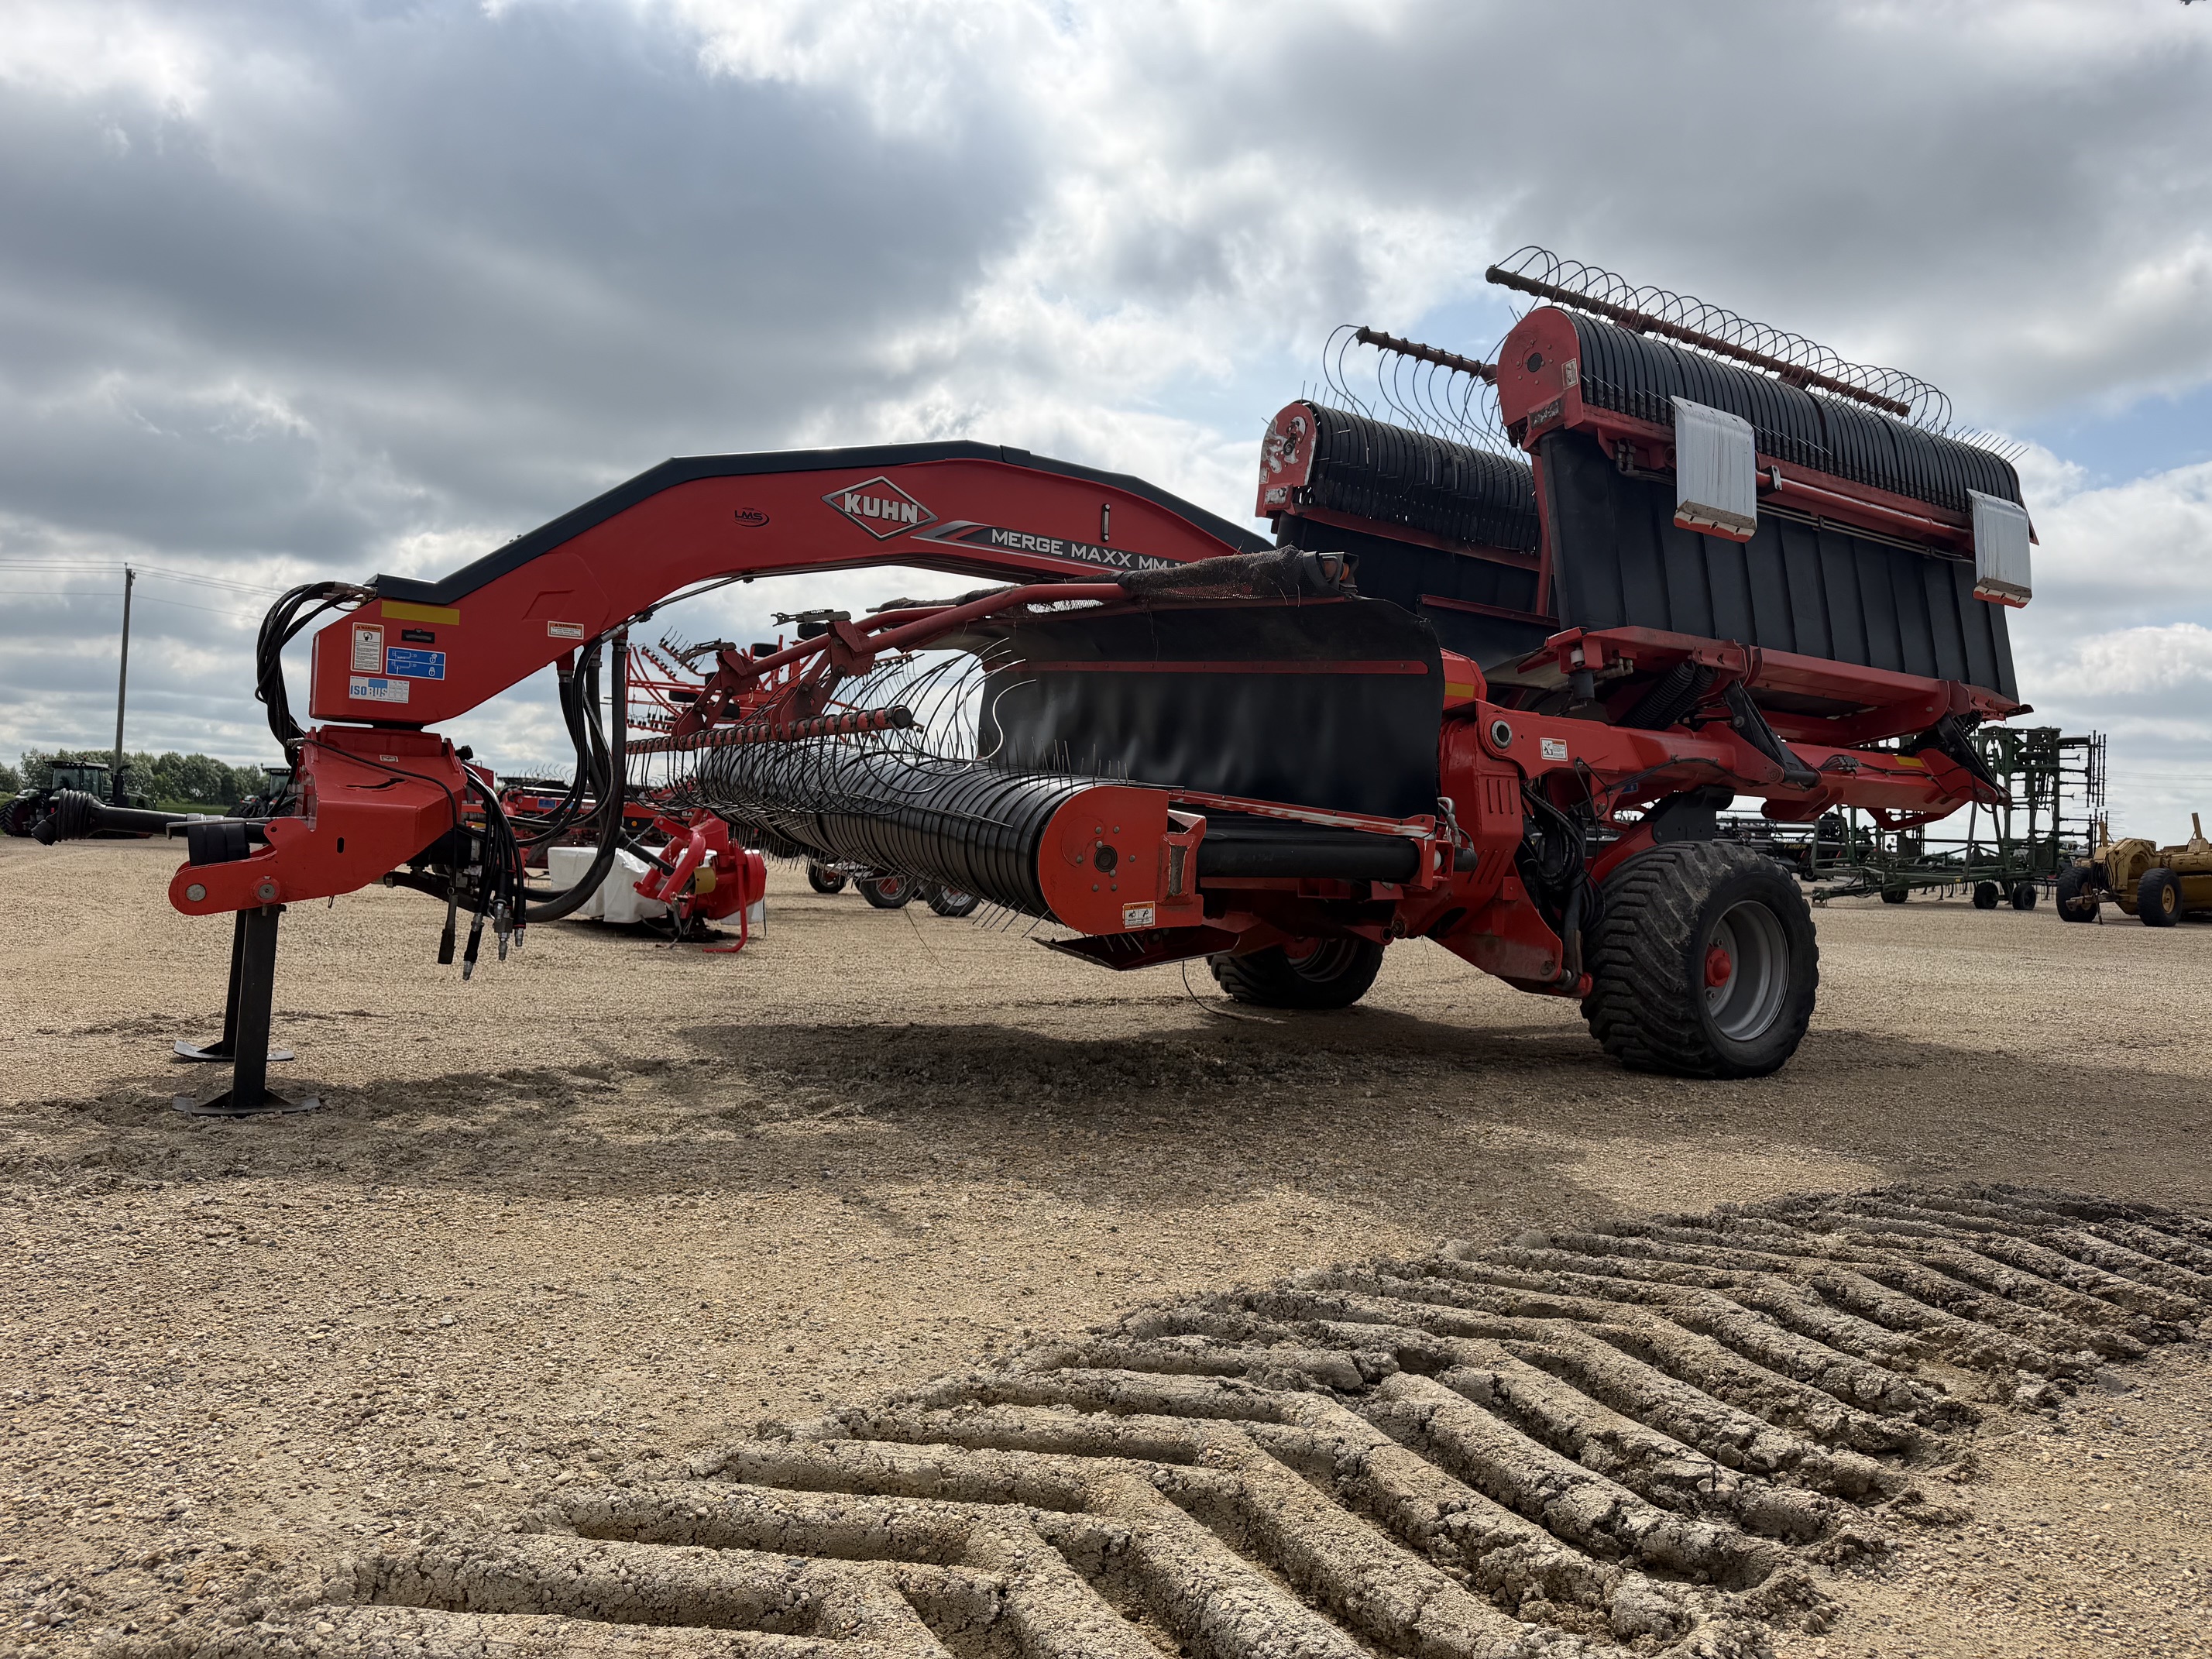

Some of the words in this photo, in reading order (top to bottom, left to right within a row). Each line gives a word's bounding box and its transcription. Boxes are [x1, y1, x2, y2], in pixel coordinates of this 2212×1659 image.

[735, 510, 763, 520] LMS
[844, 492, 918, 524] KUHN
[991, 528, 1063, 555] MERGE
[1071, 544, 1132, 568] MAXX
